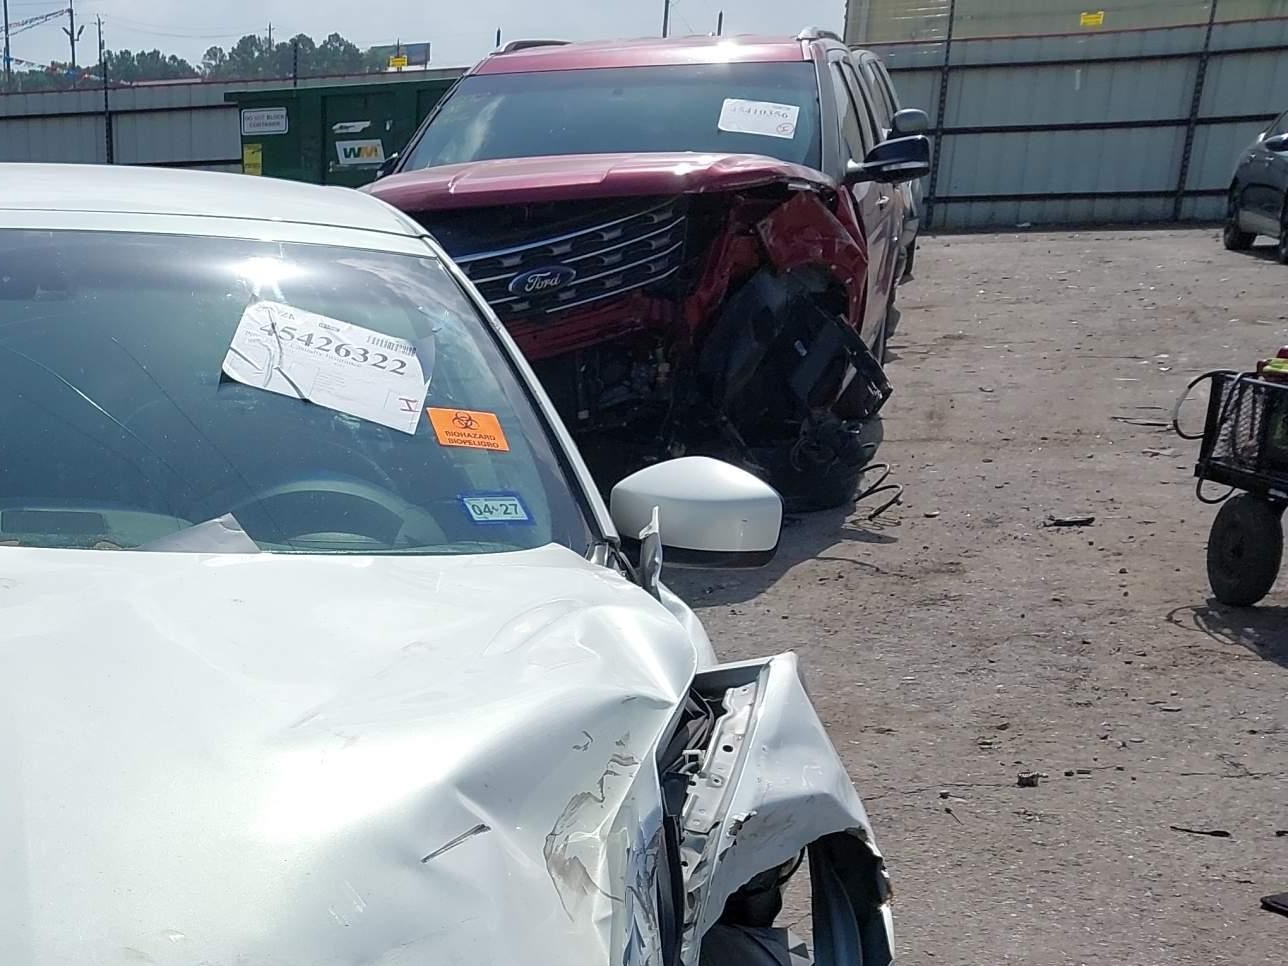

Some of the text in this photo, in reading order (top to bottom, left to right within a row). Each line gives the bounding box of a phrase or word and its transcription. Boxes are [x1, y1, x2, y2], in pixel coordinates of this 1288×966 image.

[343, 145, 377, 158] WM
[524, 271, 561, 292] Ford
[258, 321, 408, 376] 45426322
[444, 430, 496, 441] BIOHAZARD
[448, 438, 500, 449] BIOPELIGRO
